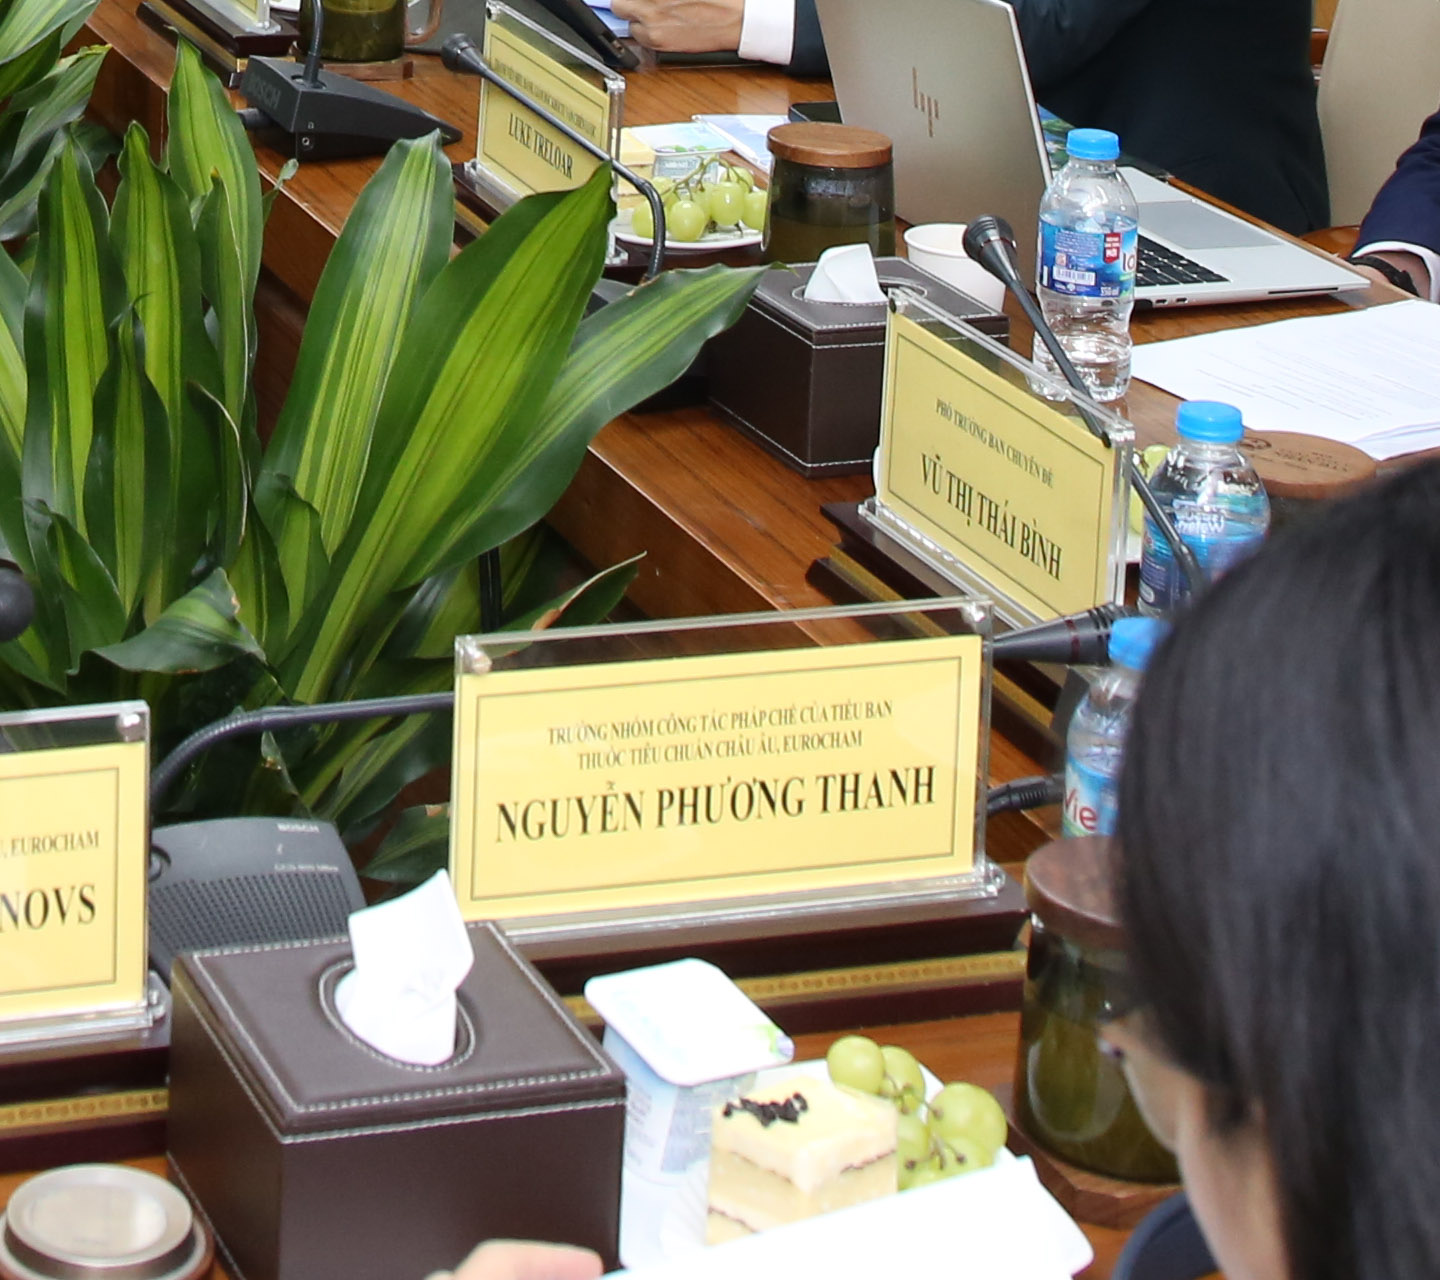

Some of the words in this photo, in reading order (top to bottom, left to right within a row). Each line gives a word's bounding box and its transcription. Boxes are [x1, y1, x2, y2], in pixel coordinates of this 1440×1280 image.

[508, 112, 532, 150] LUKE
[533, 129, 574, 180] TRELOAR
[935, 398, 952, 422] PHÓ
[988, 432, 1005, 456] BAN
[945, 470, 973, 527] THỊ
[977, 492, 1017, 550] THÁI
[1019, 519, 1063, 582] BÌNH
[610, 716, 654, 741] NHÓM
[656, 712, 697, 738] CÔNG
[700, 708, 729, 734] TÁC
[731, 705, 767, 732] PHÁP
[799, 700, 829, 726] CỦA
[865, 699, 894, 721] BAN
[715, 733, 756, 760] CHÂU
[782, 728, 864, 754] EUROCHAM
[494, 780, 646, 844] NGUYỄN
[656, 776, 807, 829] PHƯƠNG
[814, 763, 937, 815] THANH
[1064, 788, 1097, 831] Vie
[10, 830, 101, 857] EUROCHAM
